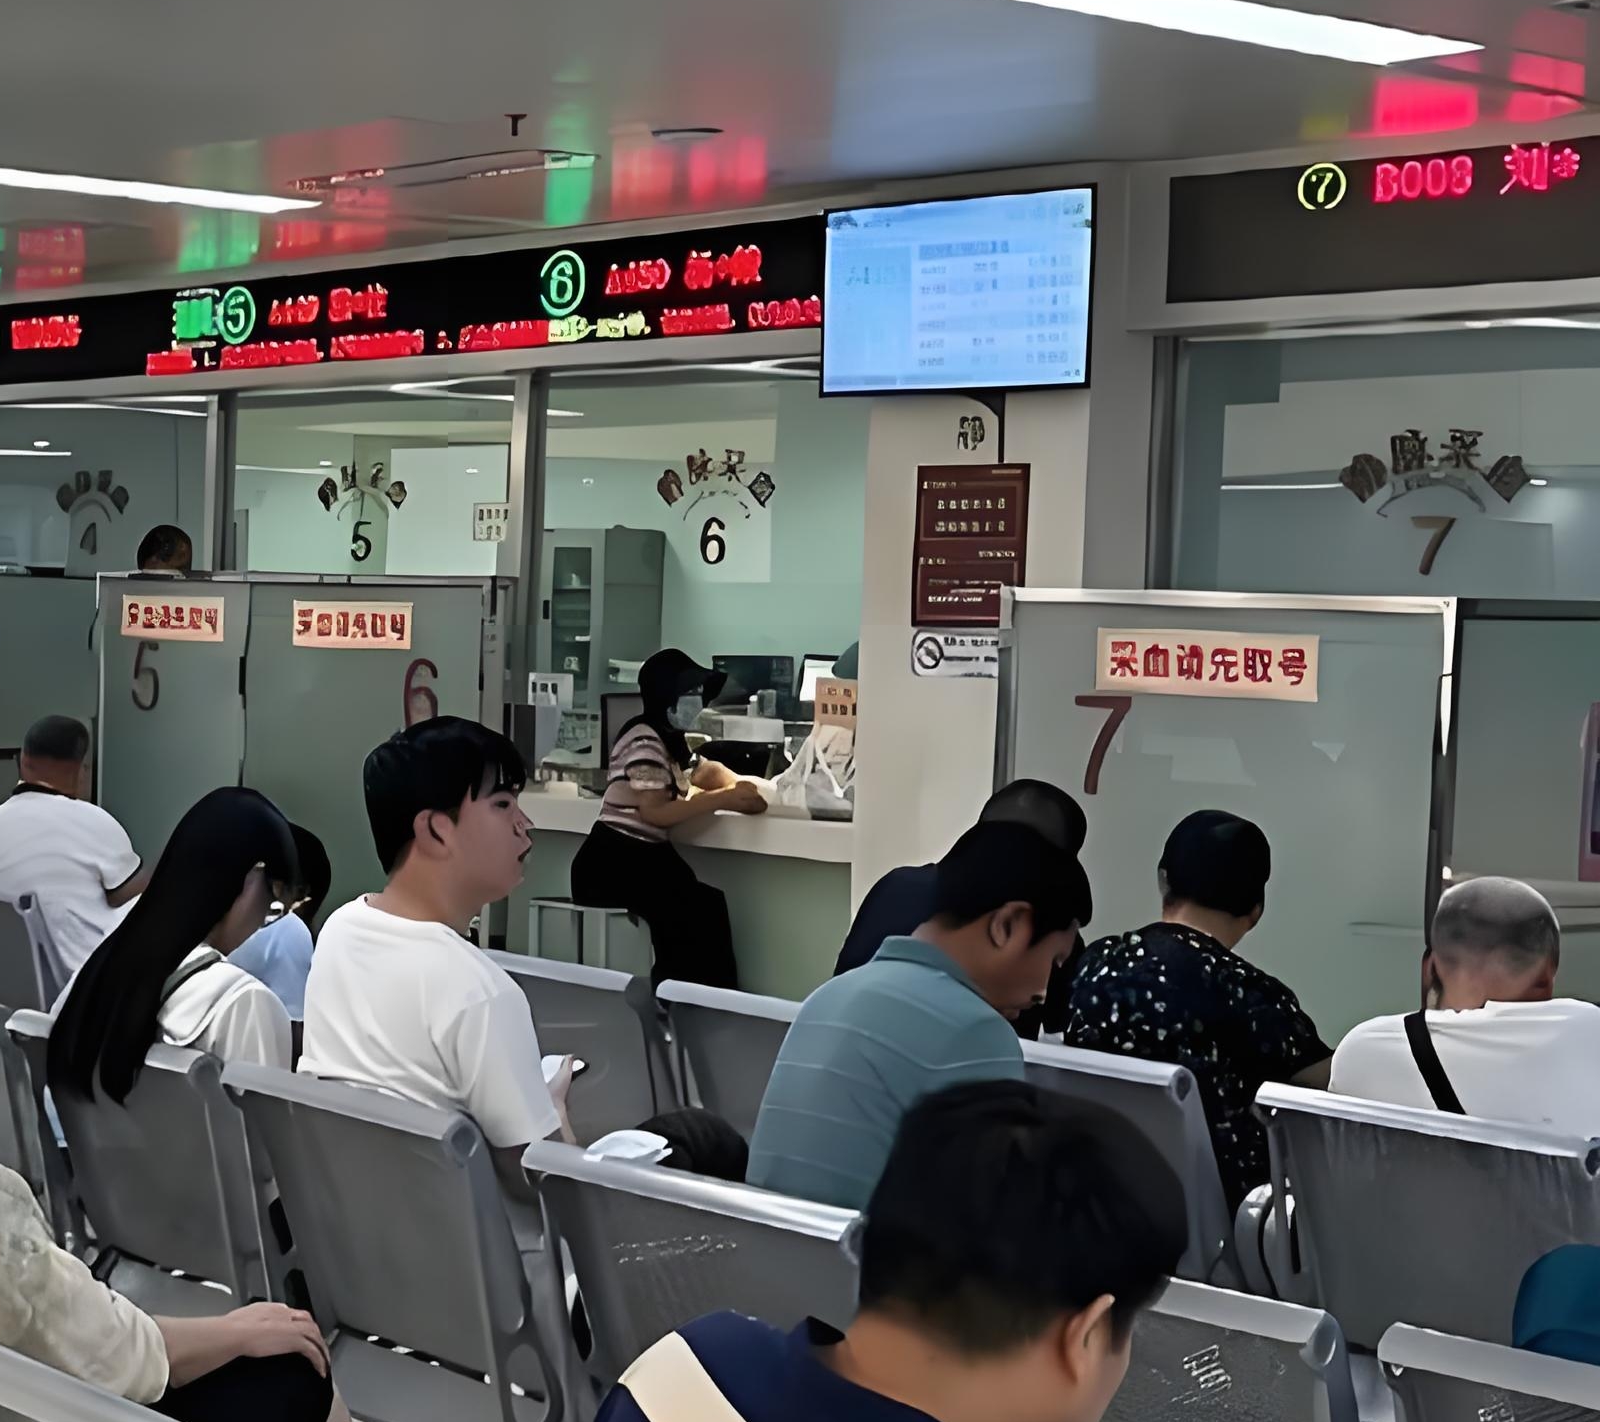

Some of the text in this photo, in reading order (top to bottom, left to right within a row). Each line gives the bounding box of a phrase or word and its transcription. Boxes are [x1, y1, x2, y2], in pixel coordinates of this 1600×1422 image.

[351, 520, 372, 562] 5
[700, 517, 726, 565] 6
[1411, 515, 1457, 576] 7
[131, 641, 160, 711] 5
[403, 657, 439, 729] 6
[1074, 695, 1132, 795] 7
